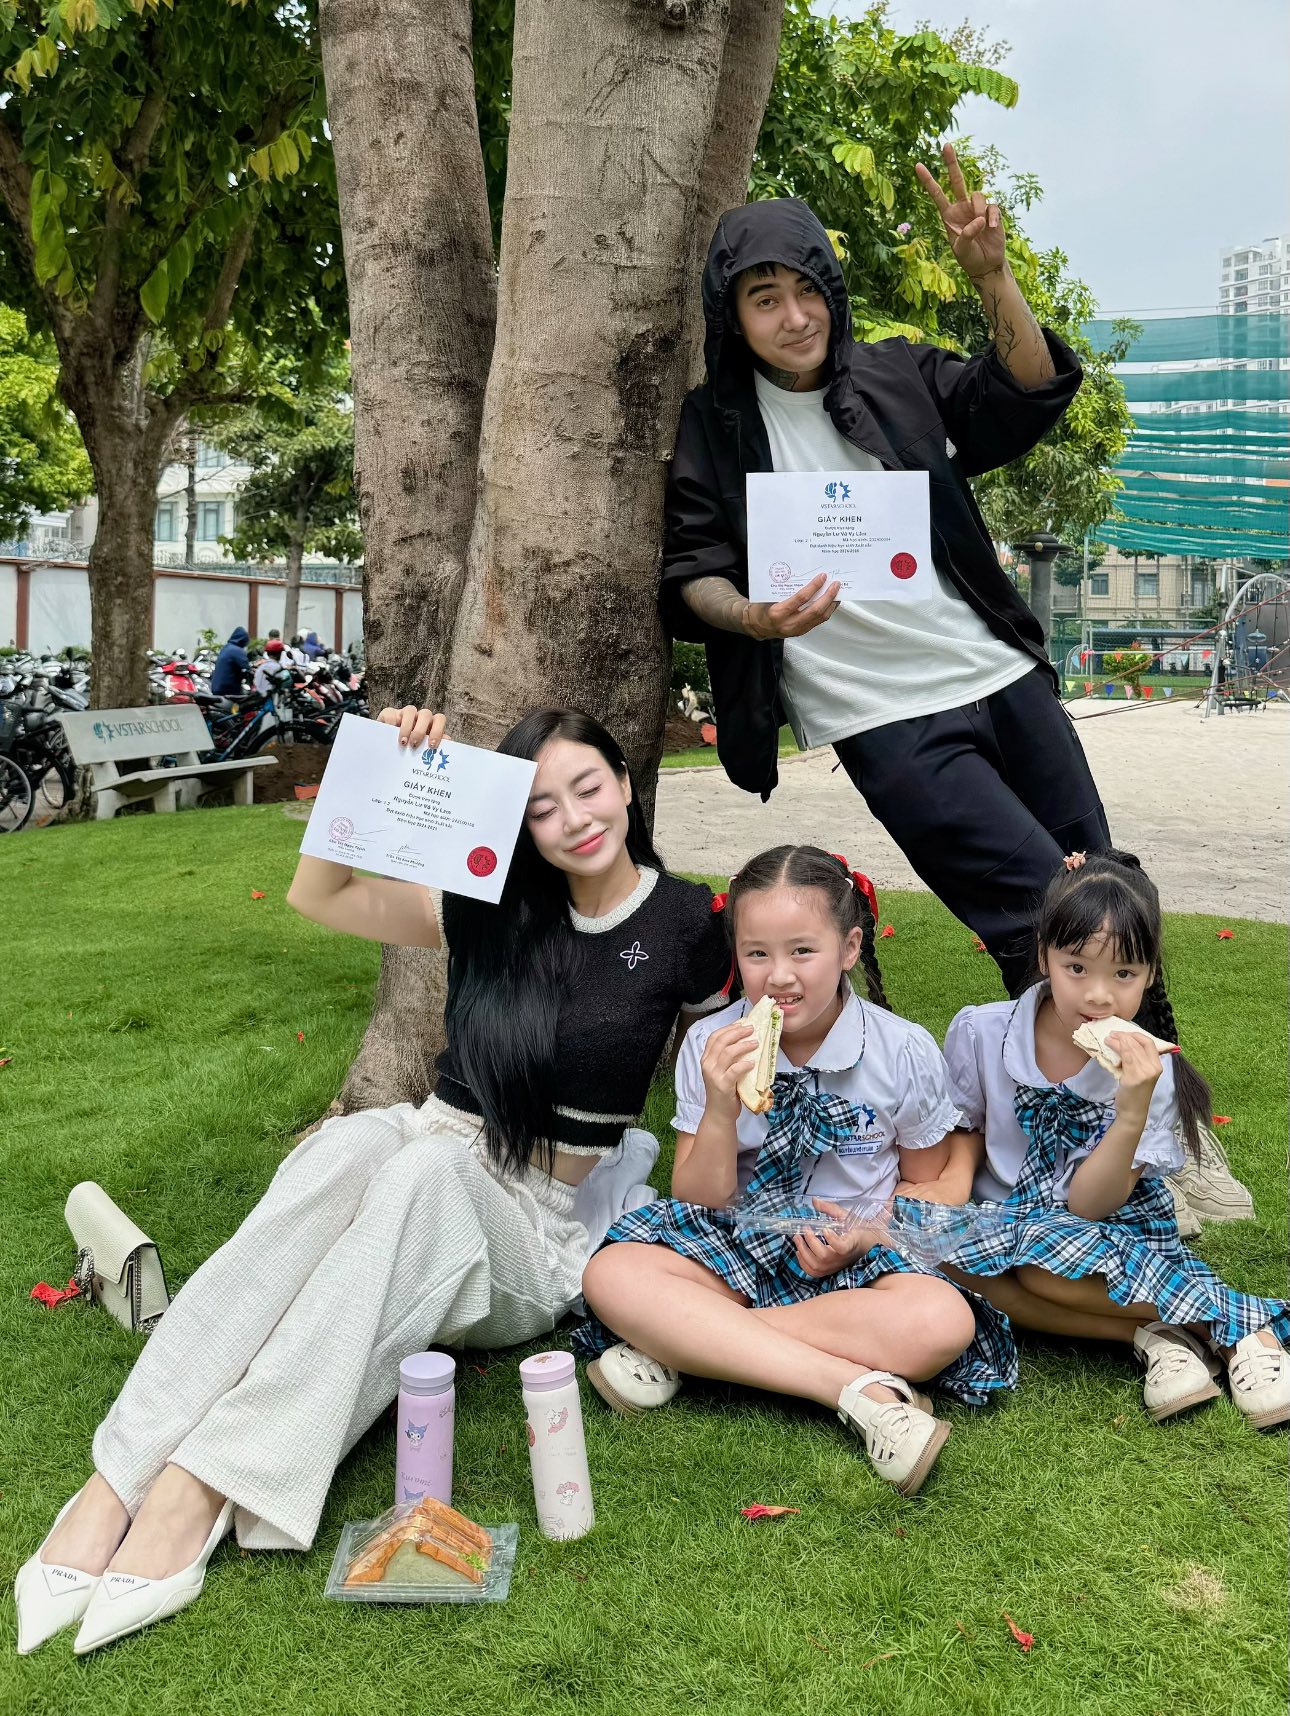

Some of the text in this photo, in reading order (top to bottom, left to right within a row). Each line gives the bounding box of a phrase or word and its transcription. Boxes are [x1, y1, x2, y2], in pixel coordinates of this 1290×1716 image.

[114, 718, 184, 736] VSTARSCHOOL
[427, 786, 452, 798] KHEN
[52, 1569, 77, 1582] PRADA
